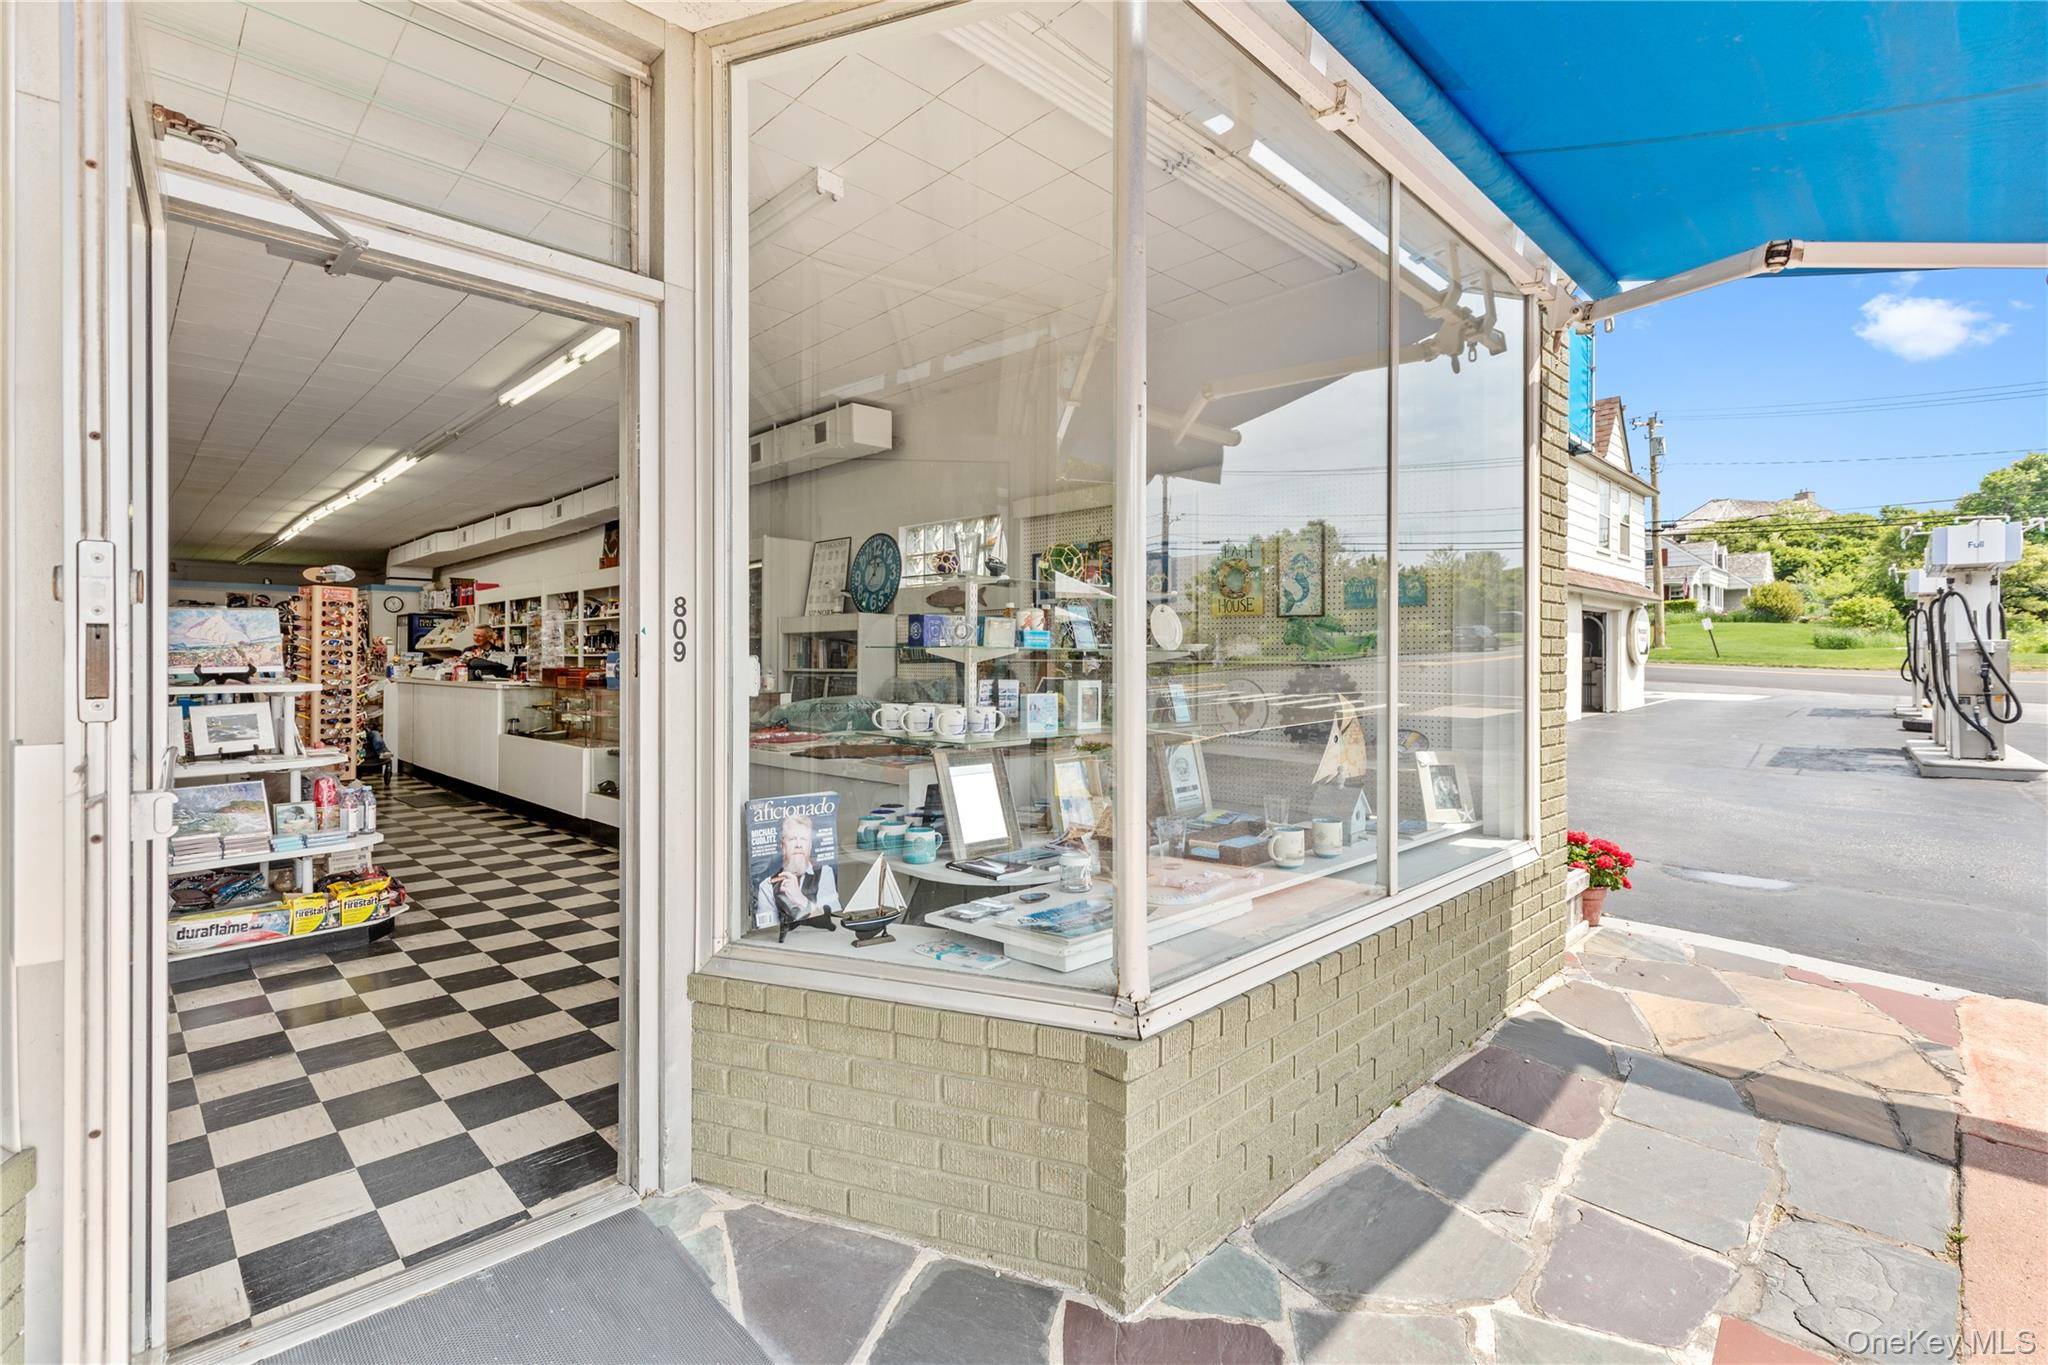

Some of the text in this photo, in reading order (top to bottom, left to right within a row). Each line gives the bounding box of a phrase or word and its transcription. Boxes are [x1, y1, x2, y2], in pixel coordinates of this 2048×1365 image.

[865, 545, 872, 560] 11
[872, 540, 883, 555] 12
[883, 543, 888, 558] 1
[1217, 544, 1254, 560] EACH
[886, 548, 894, 564] 2
[854, 570, 861, 586] 9
[889, 564, 897, 580] 3
[857, 585, 863, 600] 8
[878, 591, 885, 607] 5
[870, 594, 877, 610] 6
[1217, 597, 1255, 614] HOUSE
[818, 609, 834, 617] NORT
[672, 596, 687, 663] 809
[754, 797, 835, 822] aficionado
[751, 827, 778, 839] MICHAEL
[343, 894, 380, 911] firestart
[295, 903, 331, 919] firestart
[176, 922, 249, 941] duraflame
